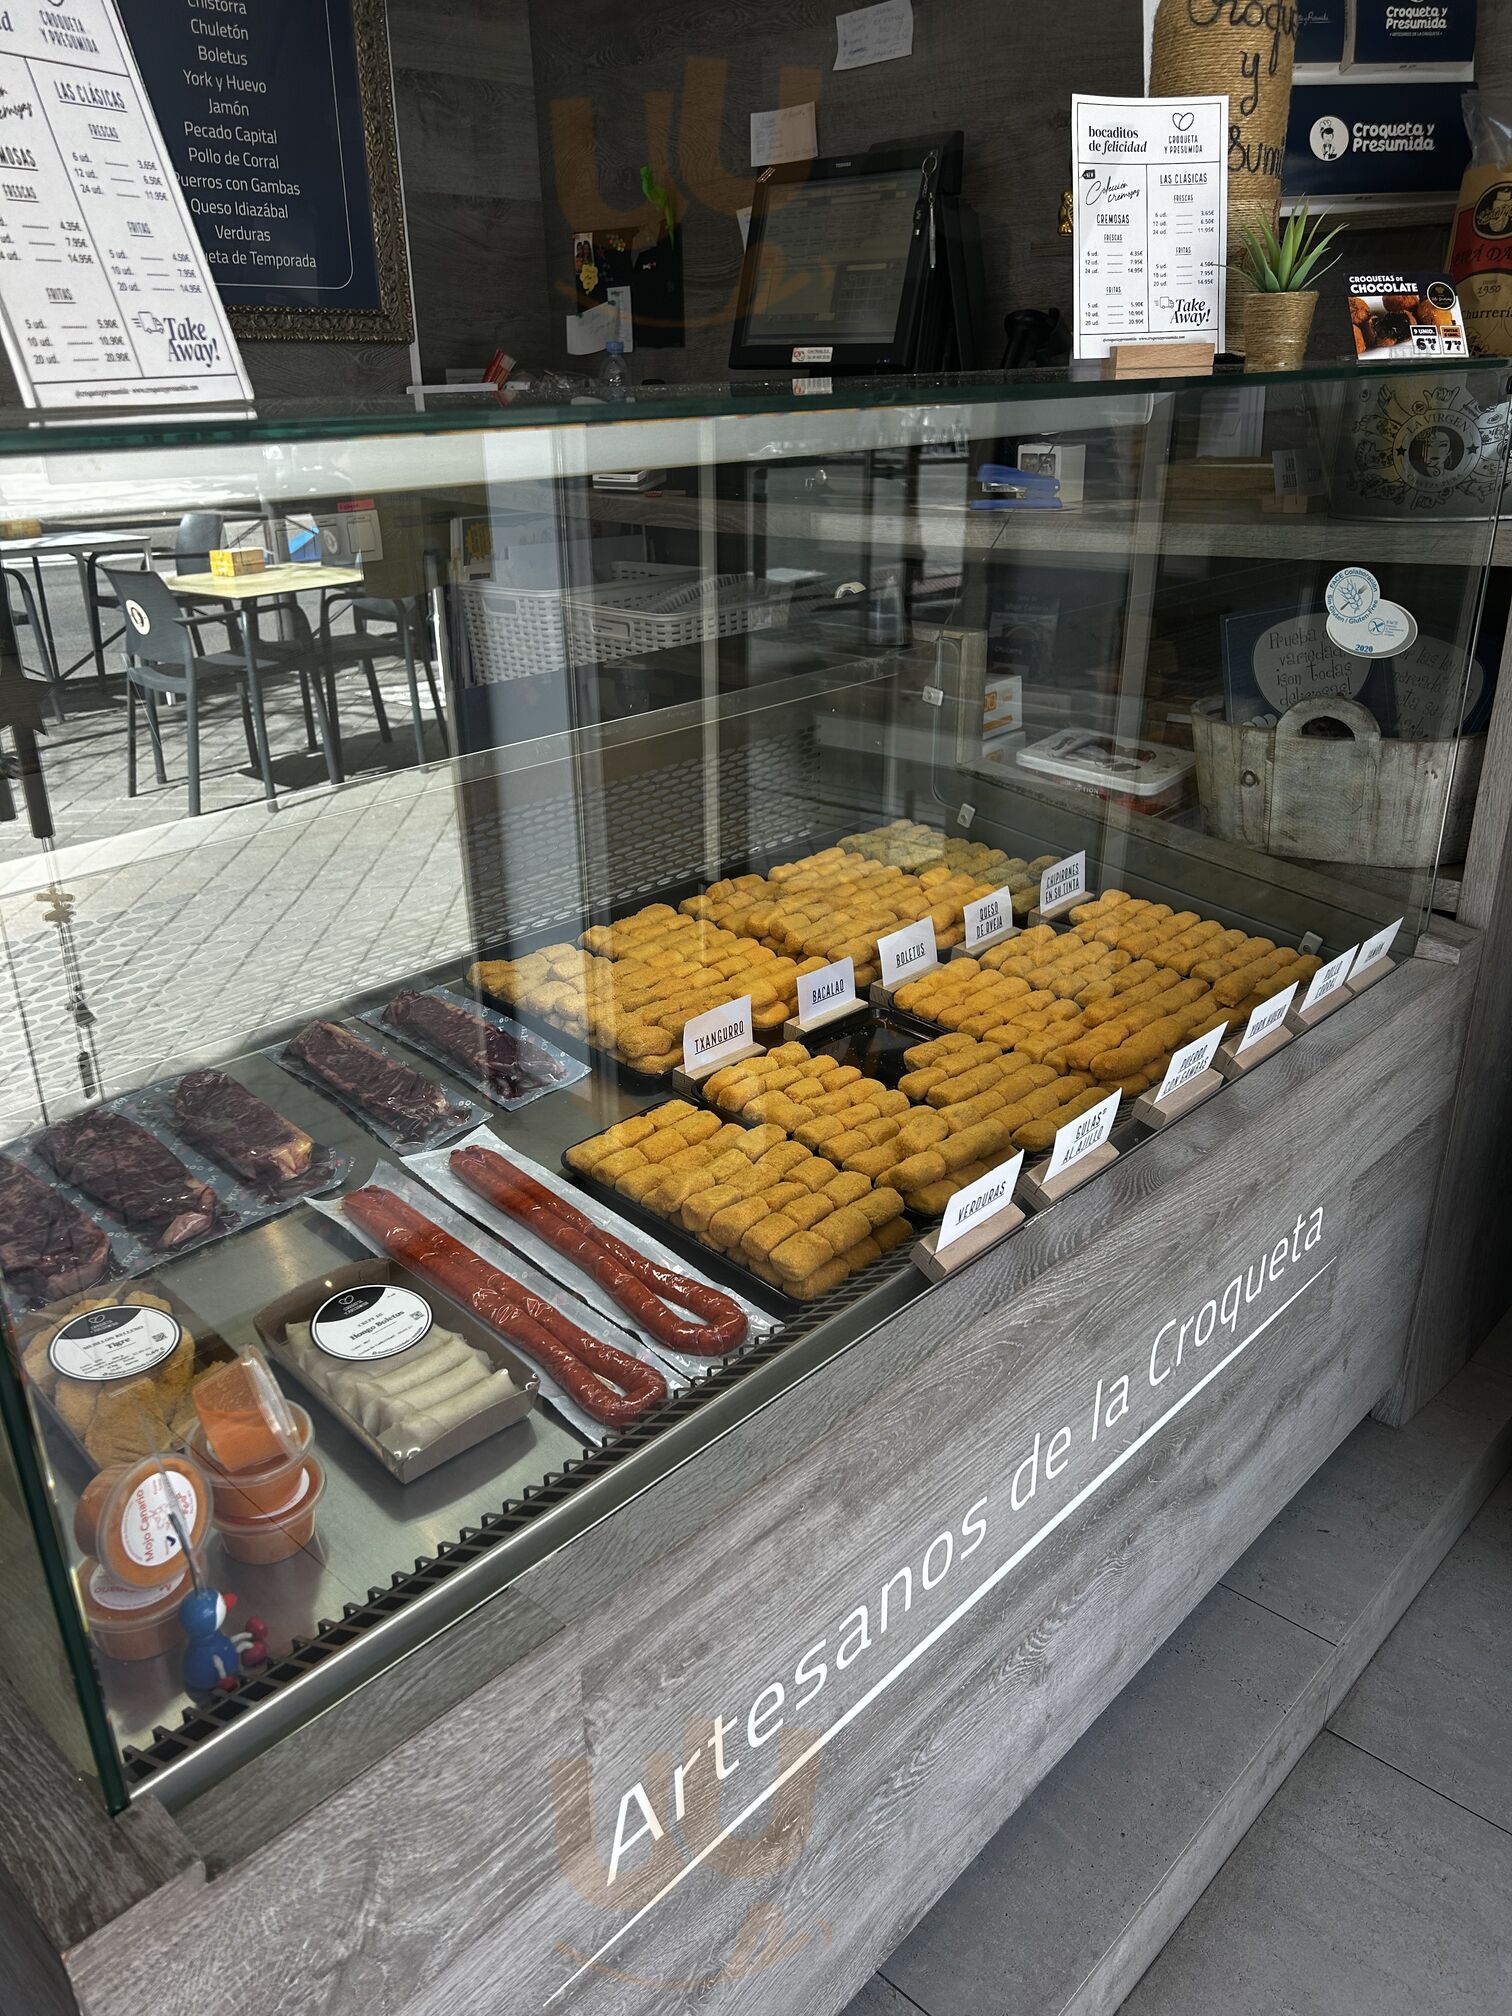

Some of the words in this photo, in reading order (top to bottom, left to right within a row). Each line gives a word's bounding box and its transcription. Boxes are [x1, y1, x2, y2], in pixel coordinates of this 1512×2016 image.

[39, 10, 86, 33] CROQUETA
[1386, 6, 1440, 19] Croqueta
[1441, 7, 1448, 17] y
[190, 18, 249, 41] Chuletón
[1386, 17, 1447, 30] Presumida
[48, 30, 99, 53] PRESUMIDA
[198, 45, 248, 66] Boletus
[183, 69, 213, 88] York
[215, 76, 223, 92] y
[226, 74, 267, 94] Huevo
[1240, 50, 1260, 117] y
[54, 80, 76, 101] LAS
[76, 82, 126, 109] CLÁSICAS
[209, 98, 250, 117] Jamón
[88, 124, 118, 139] FRESCAS
[184, 121, 232, 140] Pecado
[235, 126, 278, 146] Capital
[1089, 126, 1138, 138] bocaditos
[1169, 135, 1198, 144] CROQUETA
[1352, 122, 1425, 139] Croqueta
[1426, 123, 1435, 136] y
[1089, 140, 1101, 151] de
[1102, 140, 1147, 155] felicidad
[1164, 146, 1169, 154] Y
[1170, 145, 1203, 154] PRESUMIDA
[1352, 136, 1436, 153] Presumida
[188, 147, 221, 165] Pollo
[224, 150, 240, 166] de
[243, 152, 279, 169] Corral
[226, 178, 248, 191] con
[251, 177, 301, 196] Gambas
[1160, 174, 1172, 184] LAS
[1175, 171, 1207, 183] CLÁSICAS
[2, 184, 37, 199] FRESCAS
[190, 198, 231, 216] Queso
[235, 201, 288, 219] Idiazábal
[1097, 214, 1130, 224] CREMOSAS
[127, 221, 151, 234] FRITAS
[215, 224, 271, 242] Verduras
[232, 250, 247, 265] de
[250, 251, 317, 270] Temporada
[1349, 275, 1394, 283] CROQUETAS
[1350, 282, 1418, 294] CHOCOLATE
[46, 287, 73, 301] FRITAS
[1175, 299, 1205, 313] Take
[1170, 309, 1211, 326] Away!
[164, 317, 207, 341] Take
[168, 338, 221, 368] Away!
[1406, 421, 1422, 435] LA
[1425, 413, 1473, 434] VIRGEN
[1344, 569, 1378, 593] Colaboración
[1329, 605, 1345, 623] Gluten
[1355, 644, 1373, 652] 2020
[1306, 659, 1352, 681] todas
[1046, 863, 1079, 888] CHIPIRONES
[1045, 889, 1053, 903] EN
[1054, 886, 1062, 899] SU
[1063, 878, 1079, 896] TINTA
[979, 901, 999, 920] QUESO
[976, 924, 984, 938] DE
[985, 916, 1003, 934] OVEJA
[895, 942, 925, 966] BOLETUS
[812, 978, 844, 1003] BACALAO
[694, 1020, 745, 1052] TXANGURRO
[1180, 1045, 1208, 1071] PUERRO
[1163, 1075, 1178, 1095] CON
[1179, 1056, 1209, 1085] GAMBAS
[1063, 1149, 1073, 1164] AL
[1076, 1125, 1104, 1153] AJILLO
[958, 1181, 1006, 1221] VERDURAS
[350, 1325, 376, 1341] Hongo
[376, 1310, 405, 1327] Boletus
[105, 1337, 131, 1350] Tigre
[136, 1488, 150, 1531] Canario
[144, 1532, 154, 1562] Mojo
[606, 1495, 989, 1887] Artesanos
[1010, 1426, 1073, 1511] de
[1091, 1374, 1130, 1444] la
[1149, 1204, 1324, 1387] Croqueta
